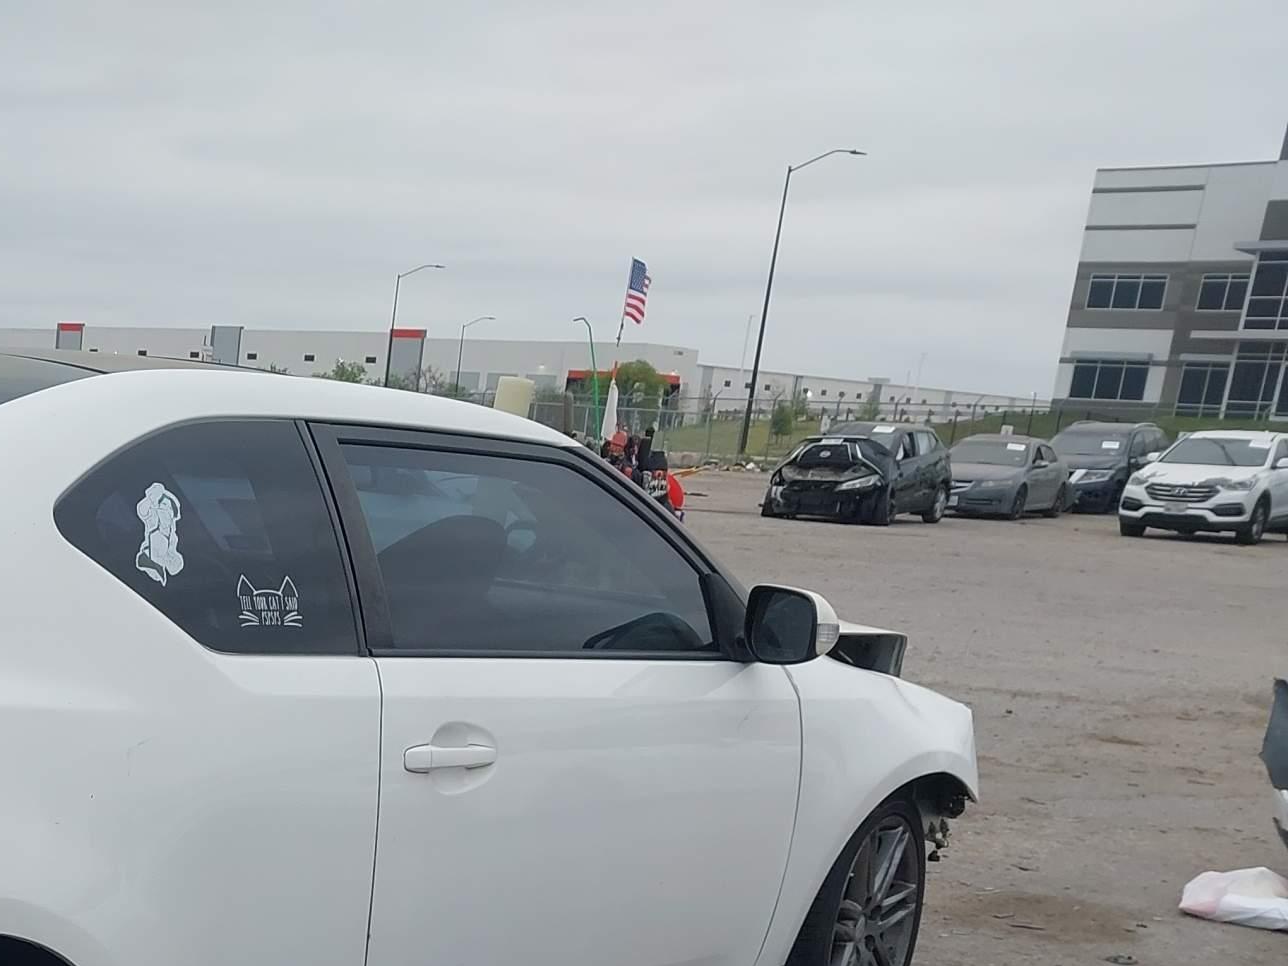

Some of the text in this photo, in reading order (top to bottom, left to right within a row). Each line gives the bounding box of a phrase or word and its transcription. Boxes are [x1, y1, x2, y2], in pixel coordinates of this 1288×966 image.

[240, 595, 253, 610] TELL
[268, 596, 280, 610] CAT
[285, 596, 298, 610] SAID
